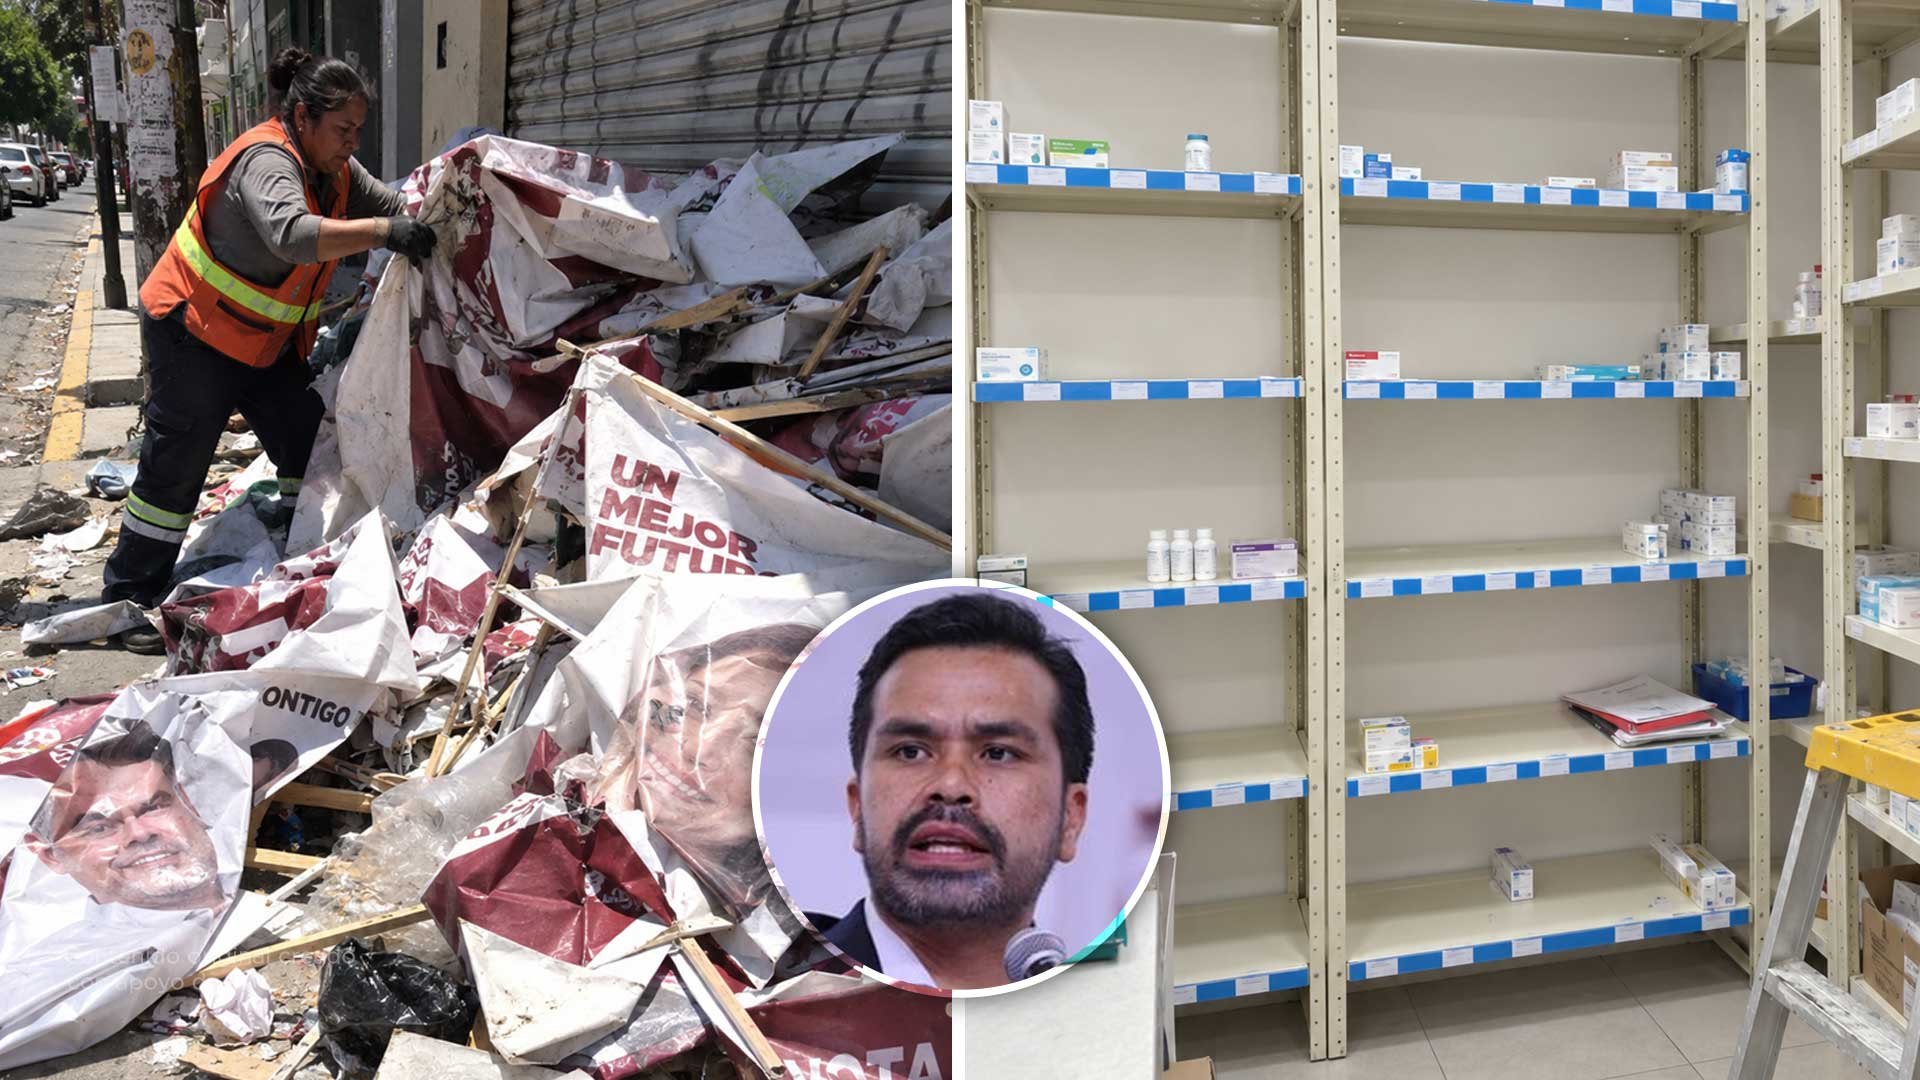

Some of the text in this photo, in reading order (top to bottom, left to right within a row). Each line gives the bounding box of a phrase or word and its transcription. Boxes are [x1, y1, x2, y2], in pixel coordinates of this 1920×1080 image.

[611, 454, 680, 501] UN
[589, 523, 780, 577] FUTU
[598, 488, 758, 563] MEJOR
